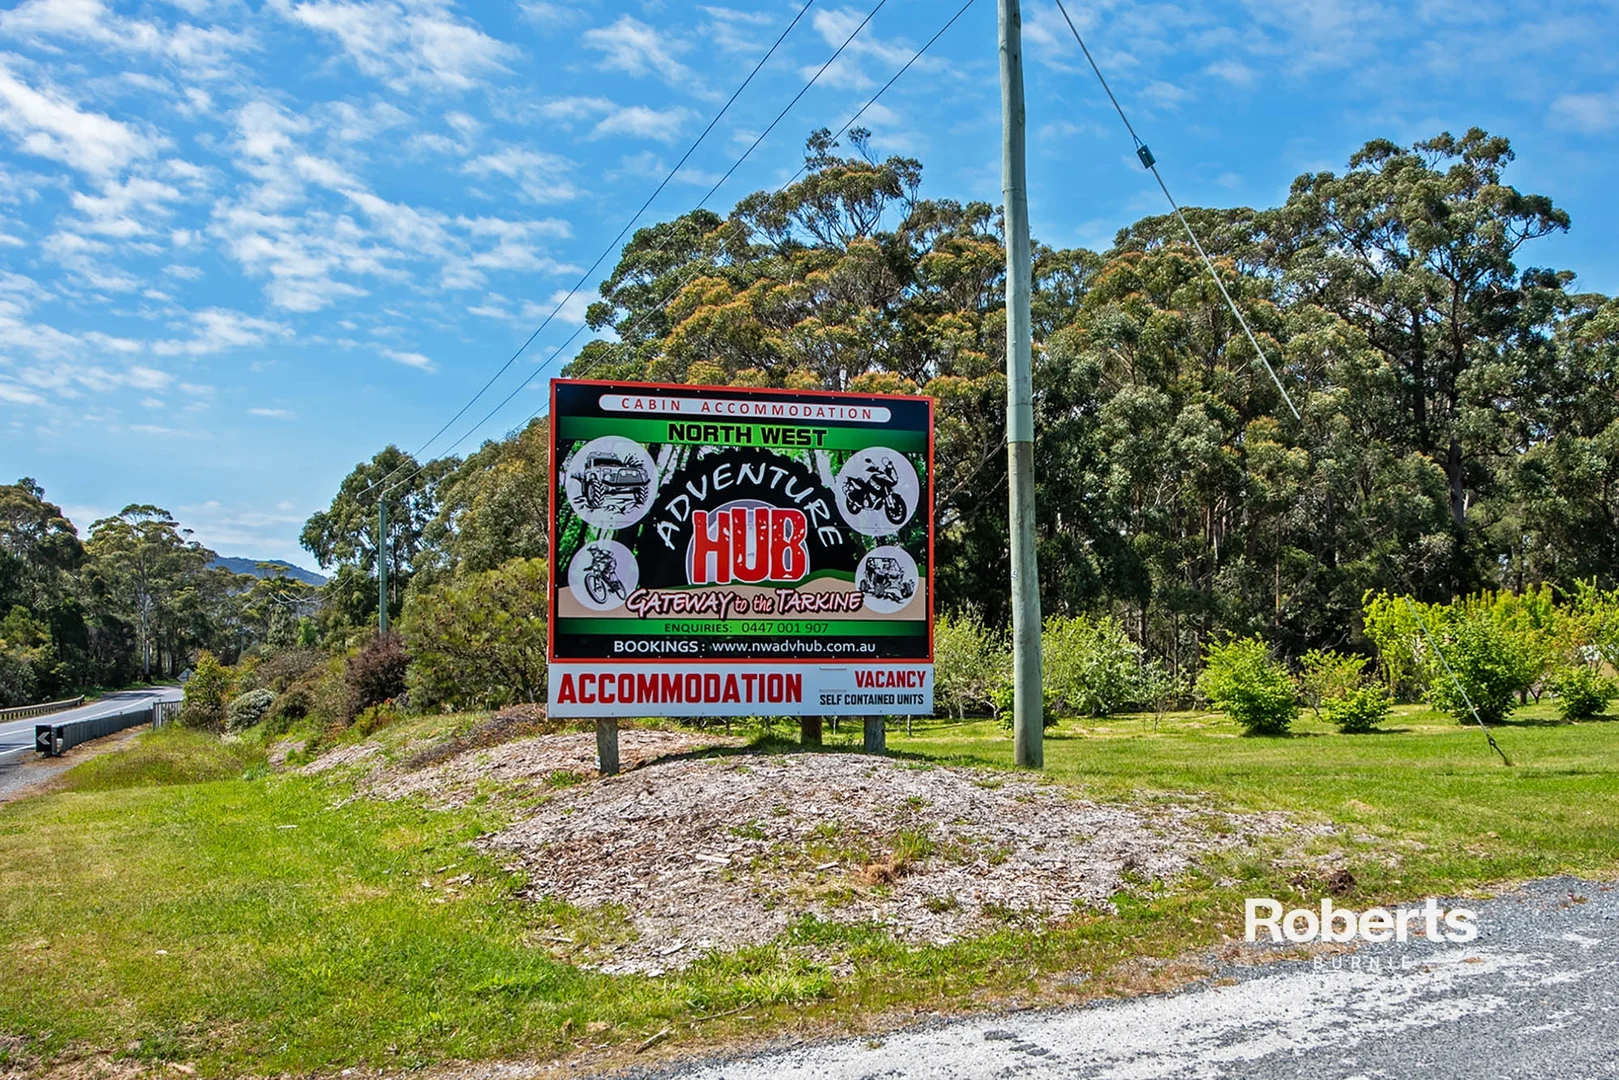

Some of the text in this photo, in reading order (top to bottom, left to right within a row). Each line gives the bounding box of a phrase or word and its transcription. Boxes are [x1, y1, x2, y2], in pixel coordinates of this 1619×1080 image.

[621, 396, 872, 420] CABIN ACCOMMODATION
[668, 423, 828, 447] NORTH WEST
[656, 462, 844, 550] ADVENTURE
[692, 506, 808, 584] HUB
[625, 587, 864, 620] GATEWAY to the TARKINE
[664, 622, 829, 634] ENQUIRIES: 0447 001 907
[712, 639, 876, 653] www.nwadvhub.com.au
[557, 673, 802, 704] ACCOMMODATION
[855, 670, 926, 688] VACANCY
[819, 693, 924, 706] SELF CONTAINED UNITS
